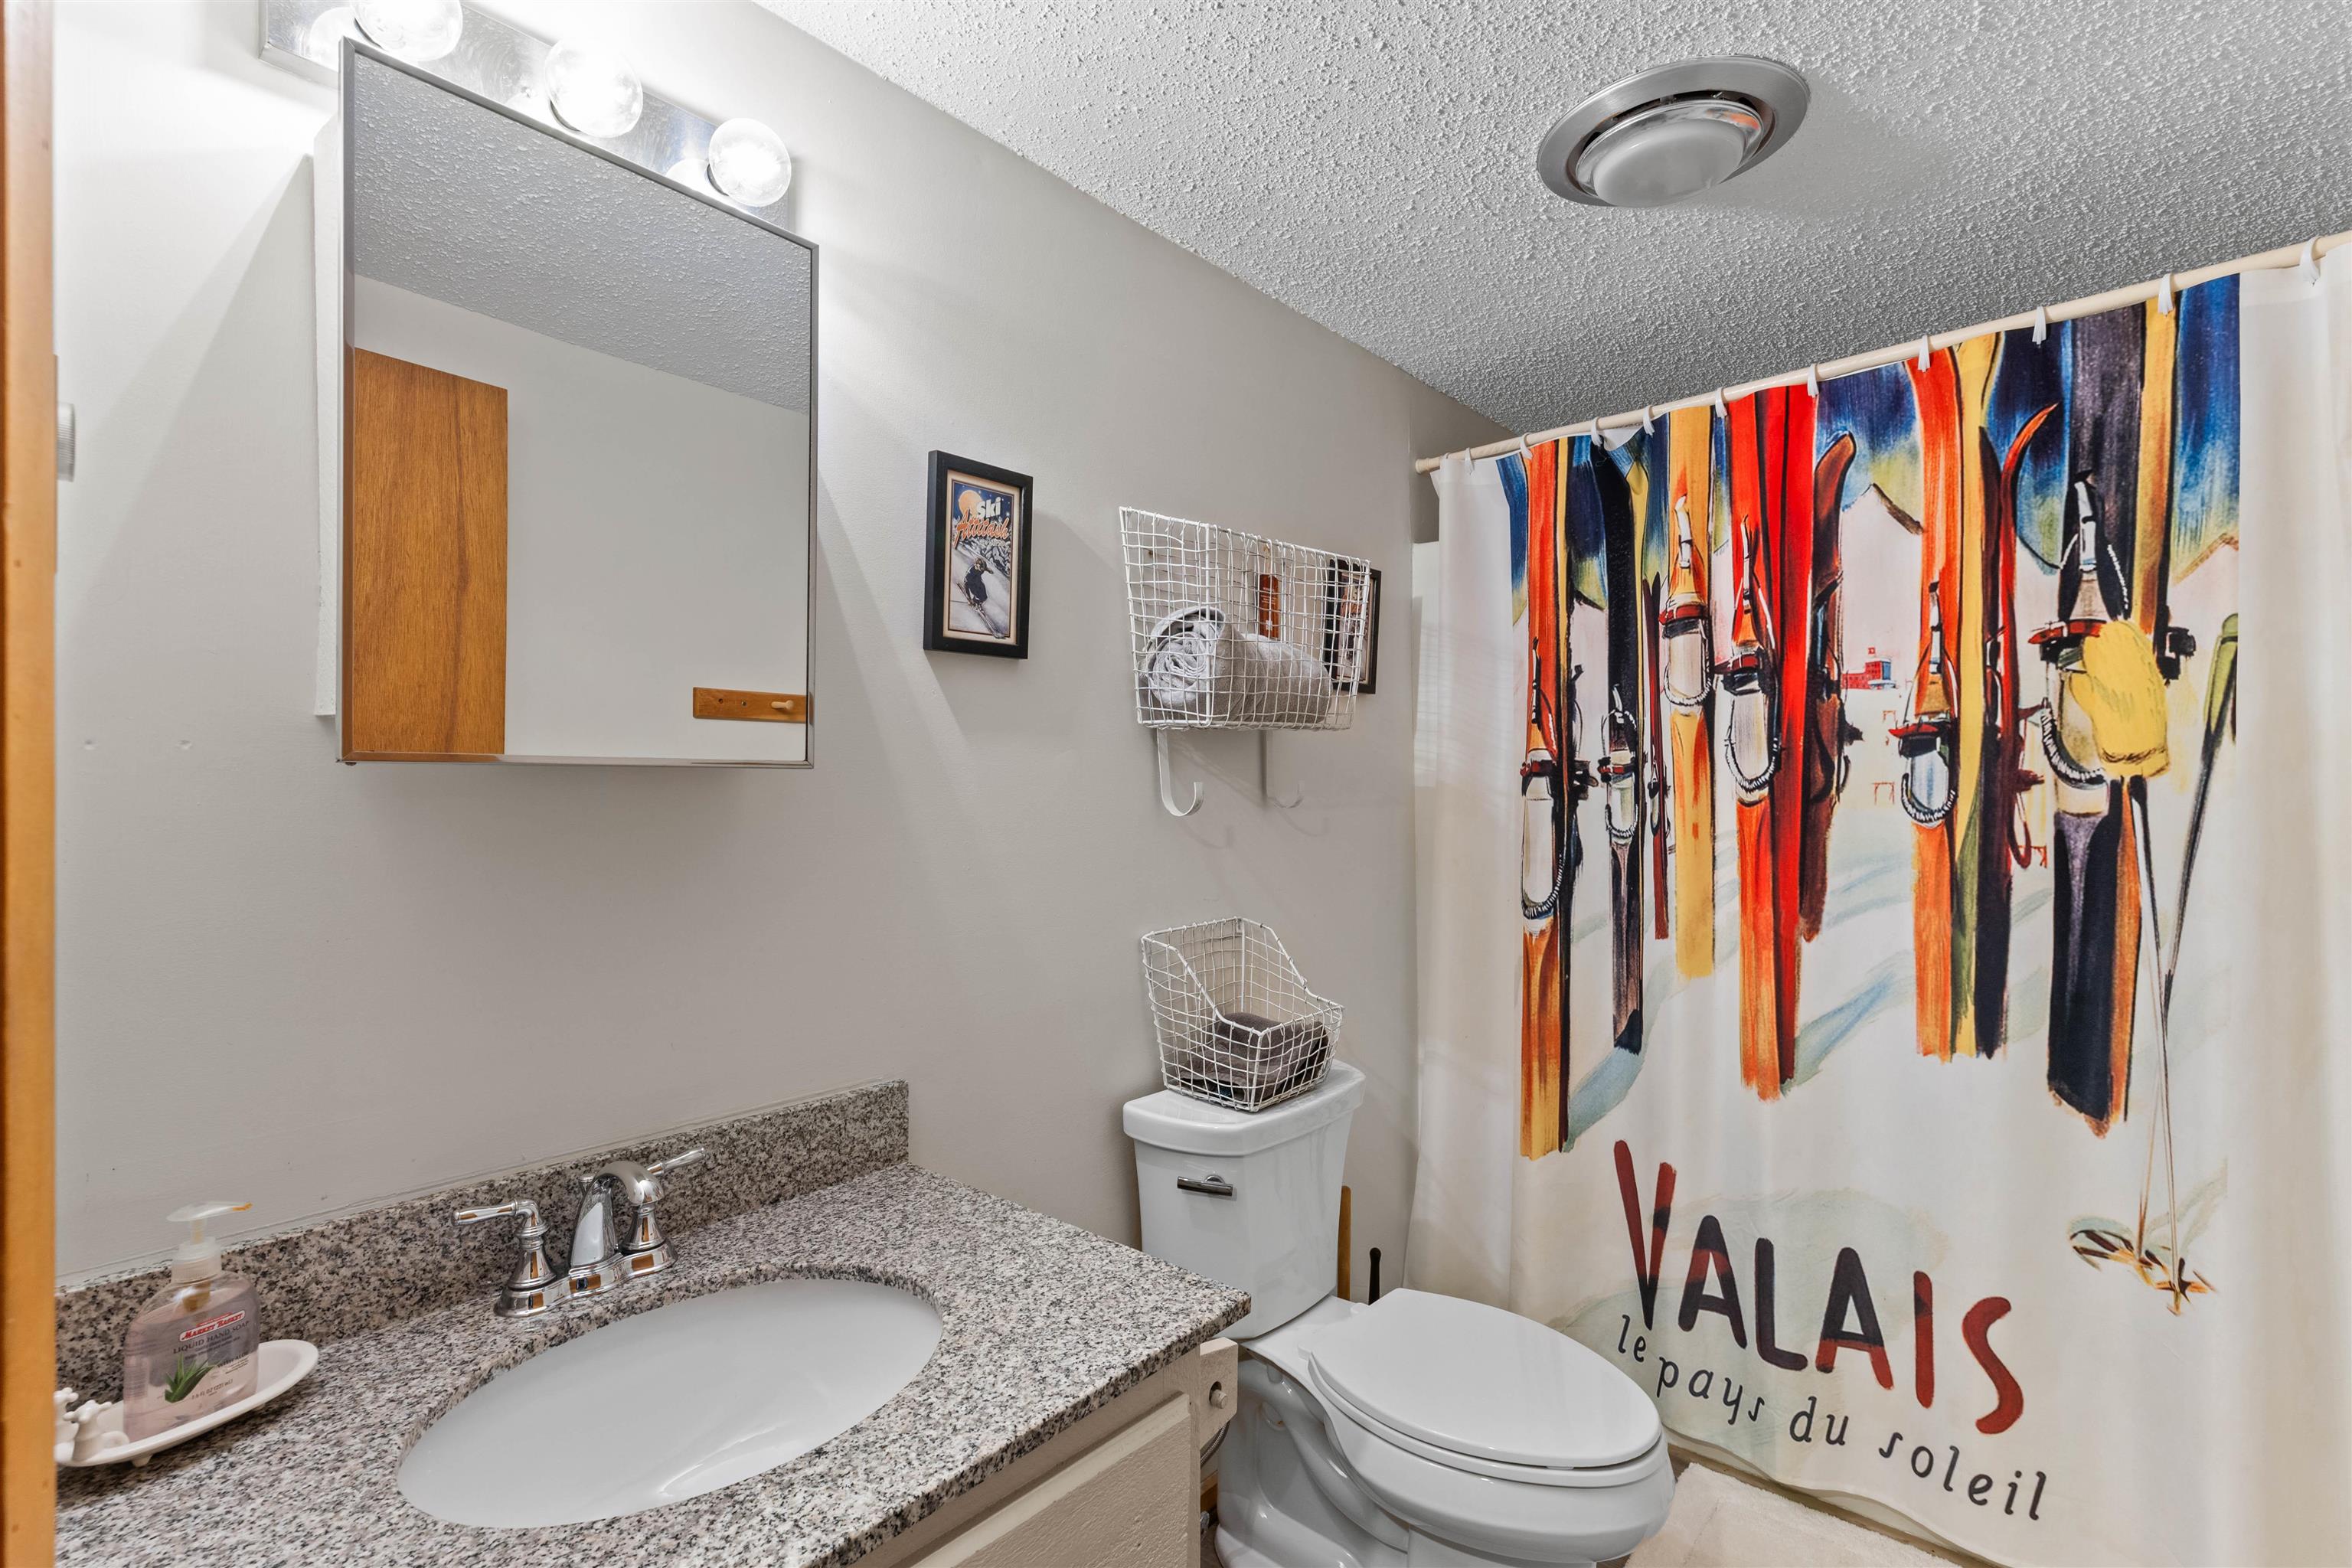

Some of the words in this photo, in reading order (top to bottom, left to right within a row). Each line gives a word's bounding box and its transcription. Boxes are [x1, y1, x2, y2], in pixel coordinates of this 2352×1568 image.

[173, 1338, 204, 1354] LIQUID
[207, 1328, 230, 1342] HAND
[232, 1321, 250, 1331] SOAP
[1614, 1140, 2024, 1434] VALAIS
[1618, 1315, 1647, 1362] le
[1656, 1357, 1765, 1425] pays
[1789, 1396, 1849, 1446] du
[1879, 1432, 2047, 1521] soleil
